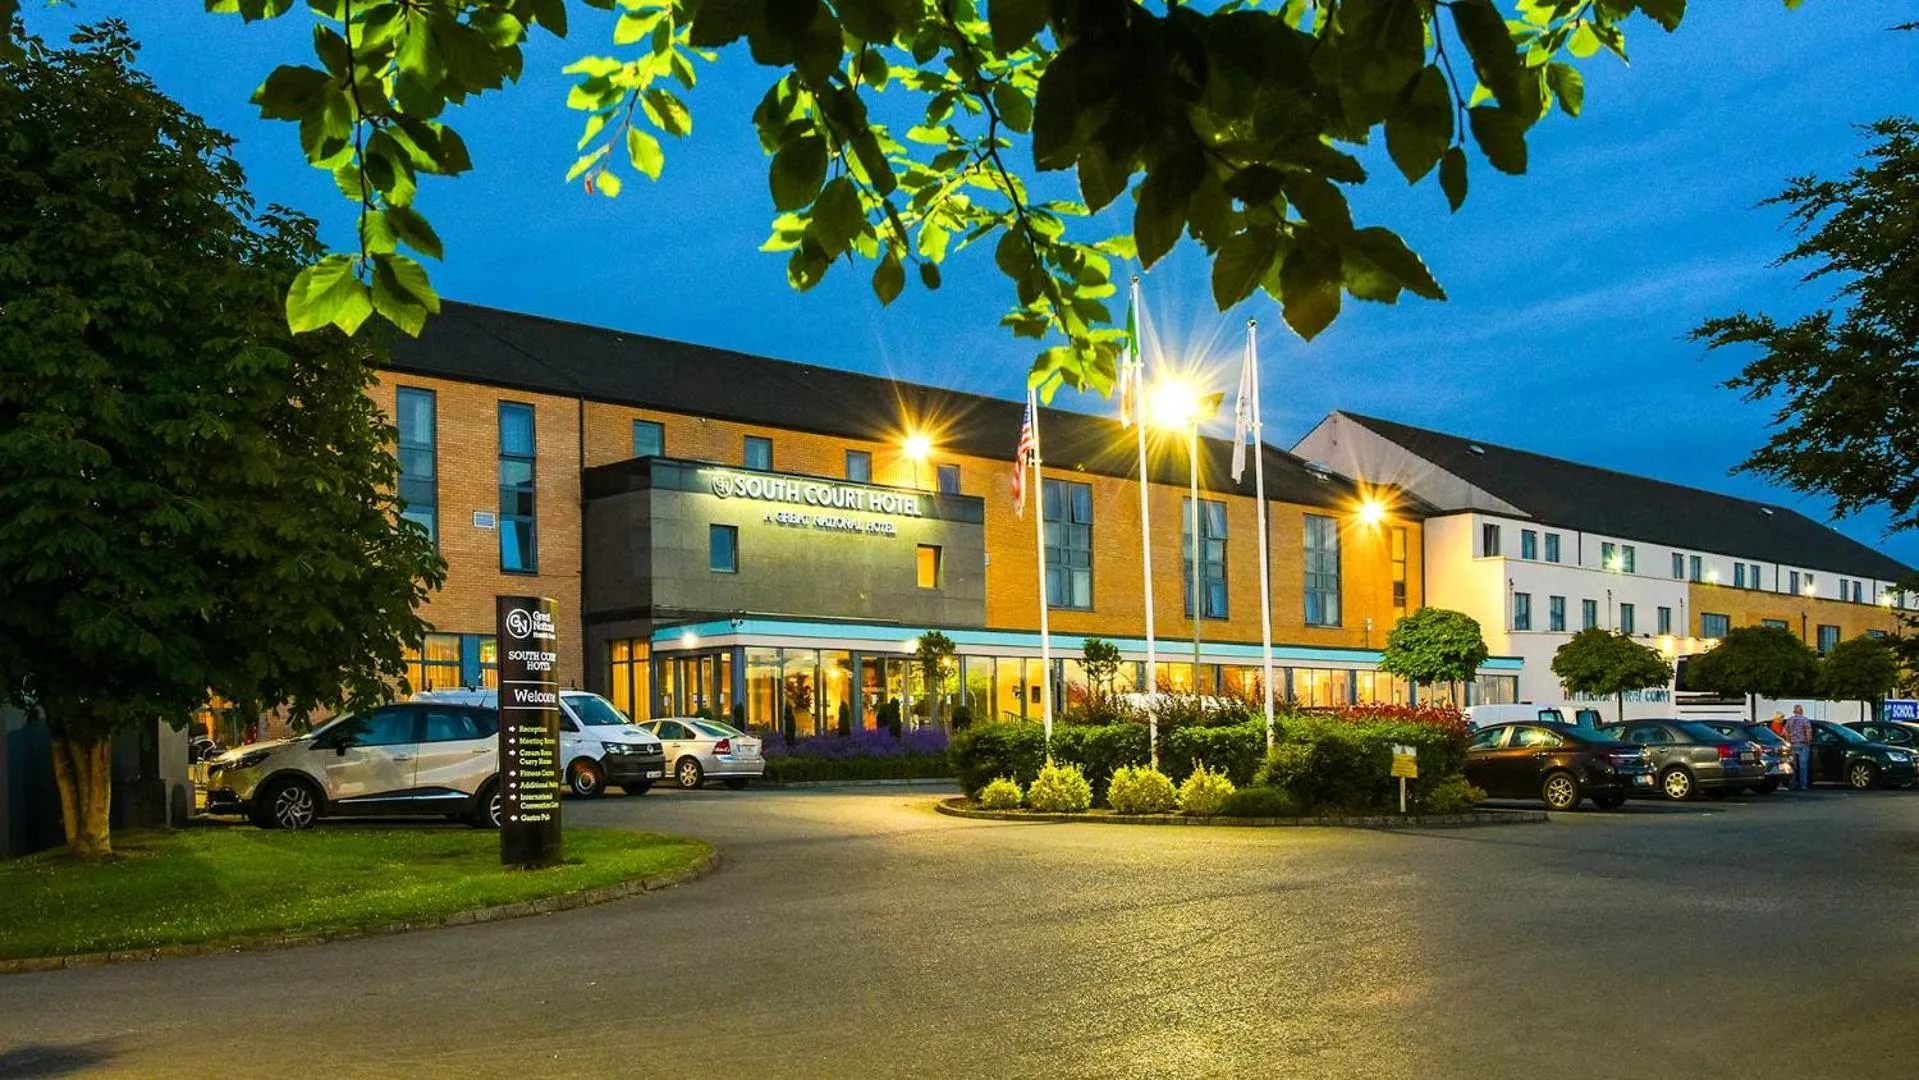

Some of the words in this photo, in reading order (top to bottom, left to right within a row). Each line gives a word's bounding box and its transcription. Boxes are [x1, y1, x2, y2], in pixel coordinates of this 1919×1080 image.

[735, 474, 800, 502] SOUTH
[804, 484, 864, 509] COURT
[869, 491, 922, 516] HOTEL
[764, 511, 772, 523] A
[776, 511, 807, 527] GREAT
[814, 515, 863, 532] NATIONAL
[867, 520, 896, 536] HOTEL
[508, 650, 540, 661] SOUTH
[527, 661, 551, 671] HOTEL
[514, 689, 556, 702] Welcom
